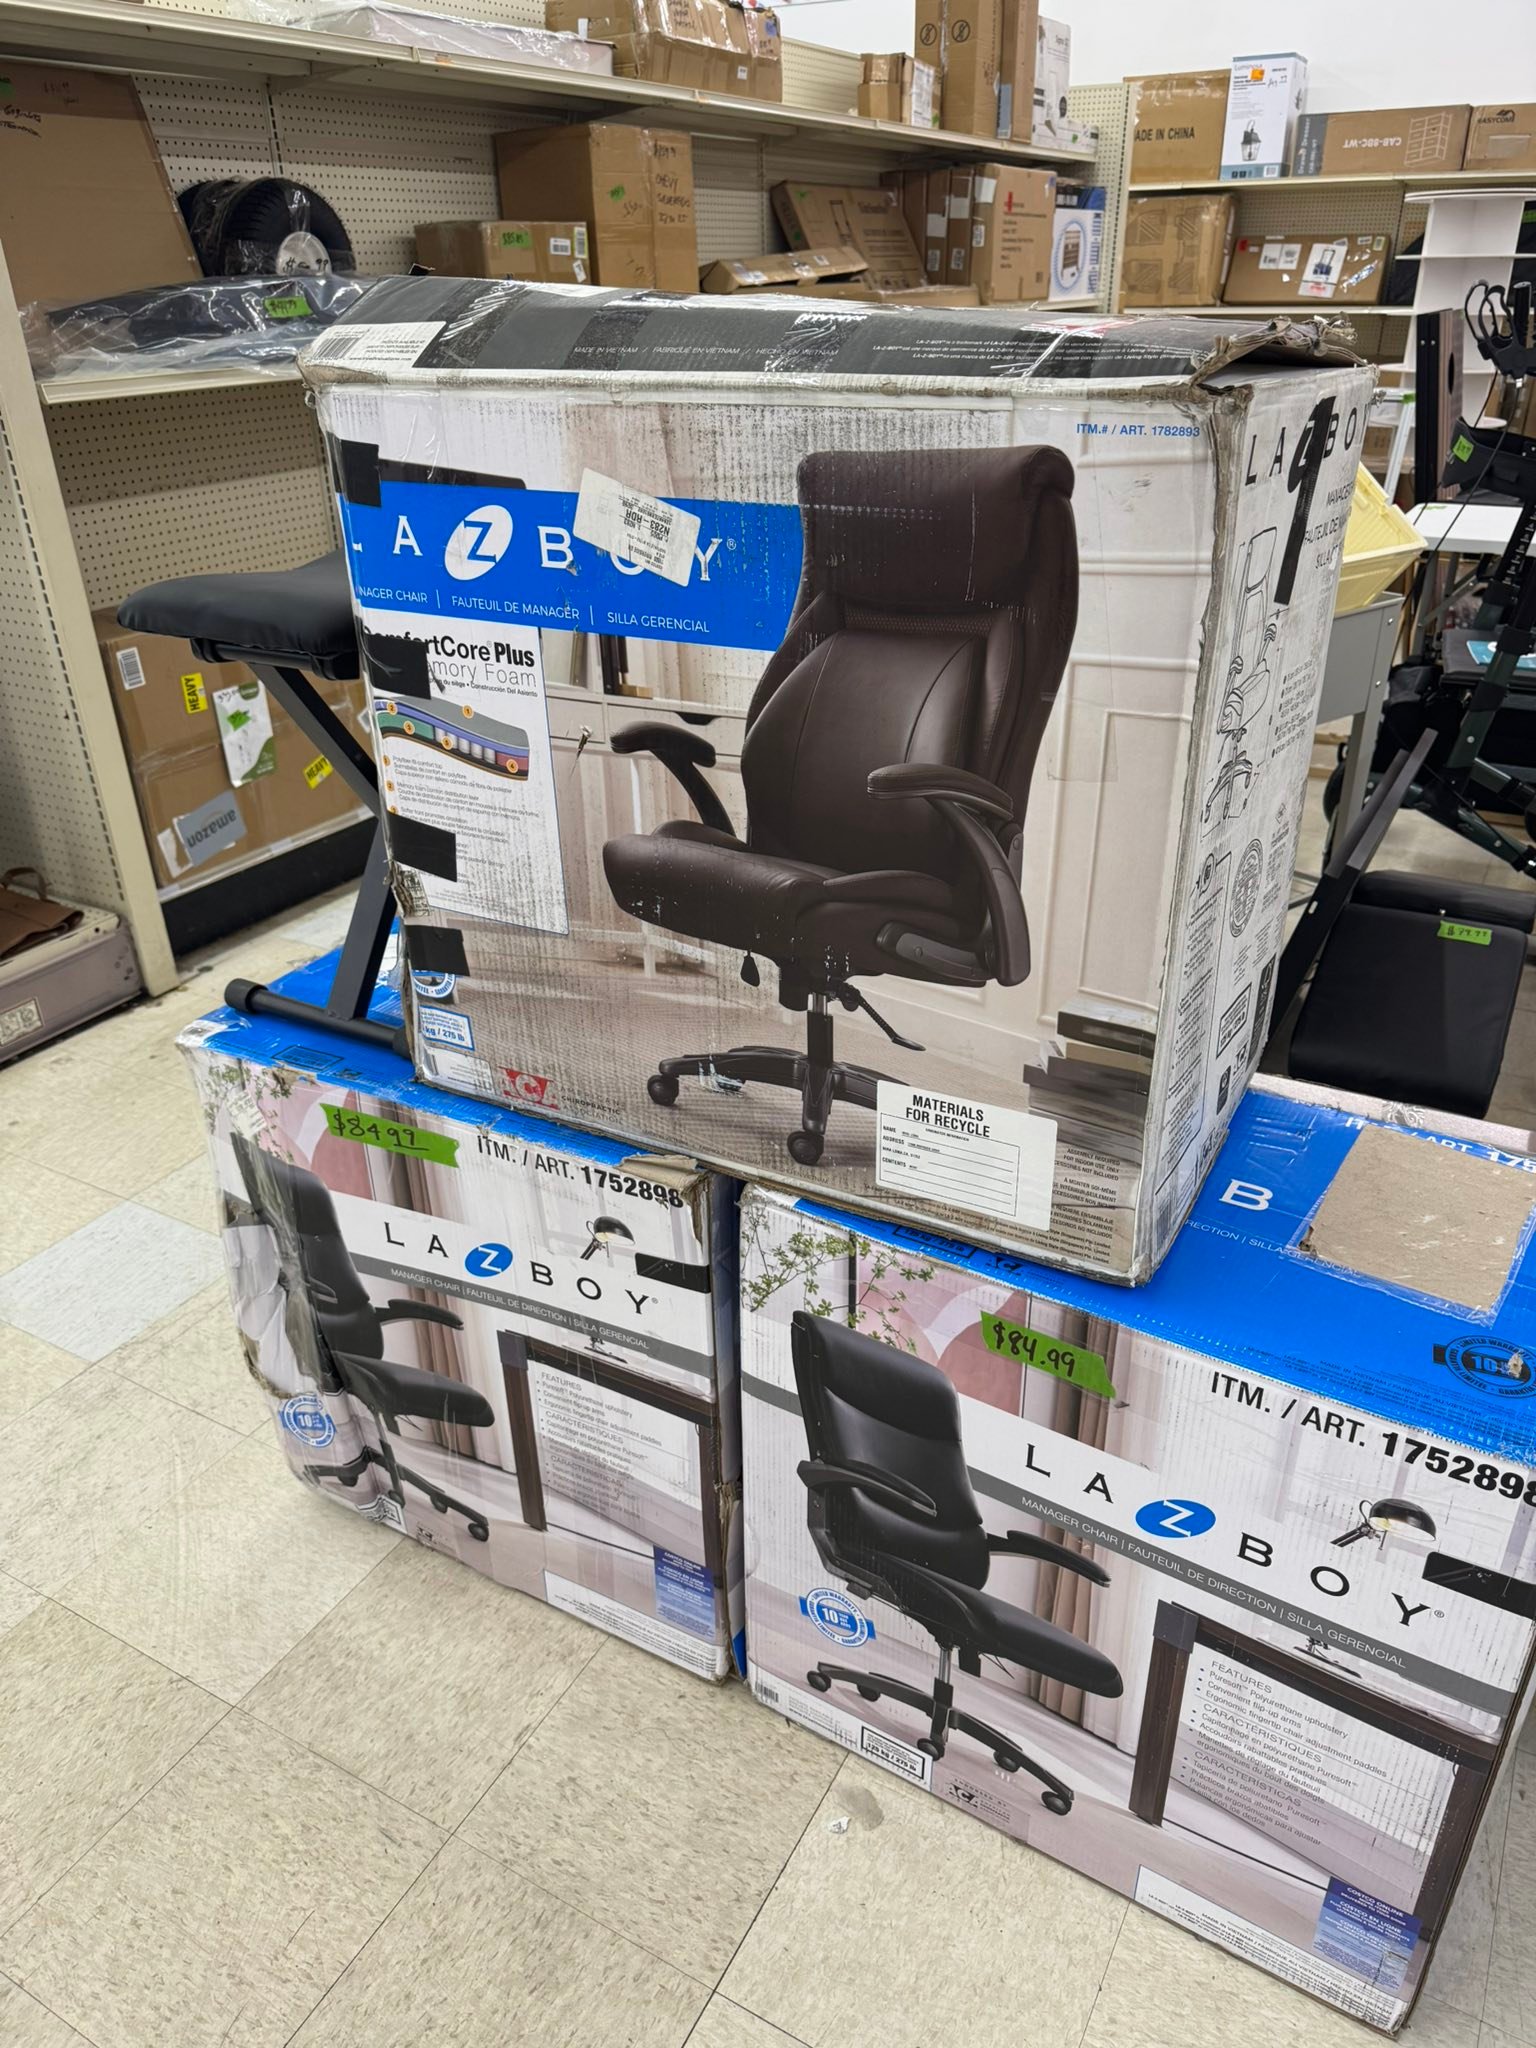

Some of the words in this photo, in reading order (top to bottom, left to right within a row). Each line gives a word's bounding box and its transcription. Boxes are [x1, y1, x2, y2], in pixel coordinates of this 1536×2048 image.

[1134, 130, 1153, 142] ADE
[1155, 128, 1164, 140] IN
[1168, 127, 1195, 140] CHINA
[1076, 424, 1108, 434] ITM.#
[1120, 424, 1147, 435] ART.
[1152, 426, 1200, 437] 1782893
[395, 590, 428, 603] CHAIR
[451, 596, 502, 612] FAUTEUIL
[504, 601, 520, 613] DE
[607, 612, 639, 626] SILLA
[640, 616, 710, 633] GERENCIAL
[494, 642, 535, 668] Plus
[485, 663, 537, 688] Foam
[184, 676, 199, 713] HEAVY
[187, 808, 238, 849] amazon
[442, 1029, 456, 1040] 275
[458, 1033, 465, 1042] lb
[912, 1094, 984, 1122] MATERIALS
[882, 1126, 896, 1134] NAME
[906, 1106, 930, 1123] FOR
[934, 1114, 990, 1138] RECYCLE
[882, 1135, 905, 1145] ADDRESS
[477, 1136, 516, 1163] ITM.
[534, 1154, 575, 1180] ART.
[580, 1166, 684, 1208] 1752898
[882, 1156, 906, 1168] CONTENTS
[1094, 1169, 1118, 1181] INCLUDED
[1106, 1166, 1120, 1174] ONLY
[1085, 1198, 1096, 1206] NON
[1248, 1238, 1283, 1254] SILLA
[391, 1268, 433, 1285] MANAGER
[434, 1279, 461, 1293] CHAIR
[466, 1286, 507, 1306] FAUTEUIL
[507, 1298, 520, 1309] DE
[521, 1302, 567, 1324] DIRECTION
[573, 1318, 598, 1334] SILLA
[598, 1324, 650, 1349] GERENCIAL
[993, 1321, 1076, 1378] $84.99
[1472, 1356, 1498, 1373] 10
[541, 1372, 582, 1392] FEATURES
[298, 1414, 312, 1428] 10
[1211, 1372, 1271, 1413] ITM.
[1280, 1398, 1298, 1420] /
[1300, 1406, 1366, 1447] ART.
[1022, 1496, 1079, 1528] MANAGER
[1082, 1523, 1118, 1546] CHAIR
[1128, 1543, 1184, 1575] FAUTEUIL
[1187, 1568, 1204, 1583] DE
[1208, 1577, 1277, 1617] DIRECTION
[1287, 1611, 1324, 1634] SILLA
[1327, 1626, 1406, 1669] GERENCIAL
[822, 1608, 839, 1624] 10
[1211, 1660, 1273, 1694] FEATURES
[1208, 1681, 1251, 1706] Convenient
[1253, 1700, 1279, 1719] flip-up
[1280, 1714, 1302, 1729] arms
[1250, 1689, 1302, 1718] Polyurethane
[1304, 1714, 1349, 1739] upholstery
[1202, 1712, 1250, 1740] Capitonnage
[1252, 1737, 1262, 1746] en
[1203, 1702, 1322, 1763] CARACTÉRISTIQUES
[1205, 1690, 1247, 1714] Ergonomic
[1248, 1710, 1282, 1730] fingertip
[1283, 1724, 1304, 1740] chair
[1306, 1738, 1352, 1763] adjustment
[1354, 1758, 1387, 1778] paddles
[1198, 1731, 1234, 1753] Manettes
[1290, 1774, 1321, 1794] fauteuil
[1200, 1722, 1242, 1747] Accoudoirs
[1243, 1742, 1288, 1768] rabattables
[1289, 1764, 1327, 1787] pratiques
[1196, 1739, 1251, 1770] ergonomiques
[1264, 1770, 1282, 1783] bout
[1284, 1780, 1299, 1792] des
[1300, 1787, 1326, 1806] doigts
[1226, 1786, 1252, 1803] brazos
[1254, 1800, 1289, 1821] abatibles
[1240, 1782, 1283, 1809] poliuretano
[1274, 1820, 1293, 1833] para
[1294, 1829, 1321, 1846] ajustar
[1347, 1887, 1376, 1904] COSTCO
[1376, 1901, 1404, 1918] ONLINE
[1202, 1913, 1219, 1924] MADE
[1228, 1926, 1254, 1942] VIETNAM
[1340, 1901, 1368, 1918] COSTCO
[1368, 1915, 1379, 1923] EN
[1380, 1920, 1402, 1934] LIGNE
[1340, 1920, 1366, 1936] COSTCO
